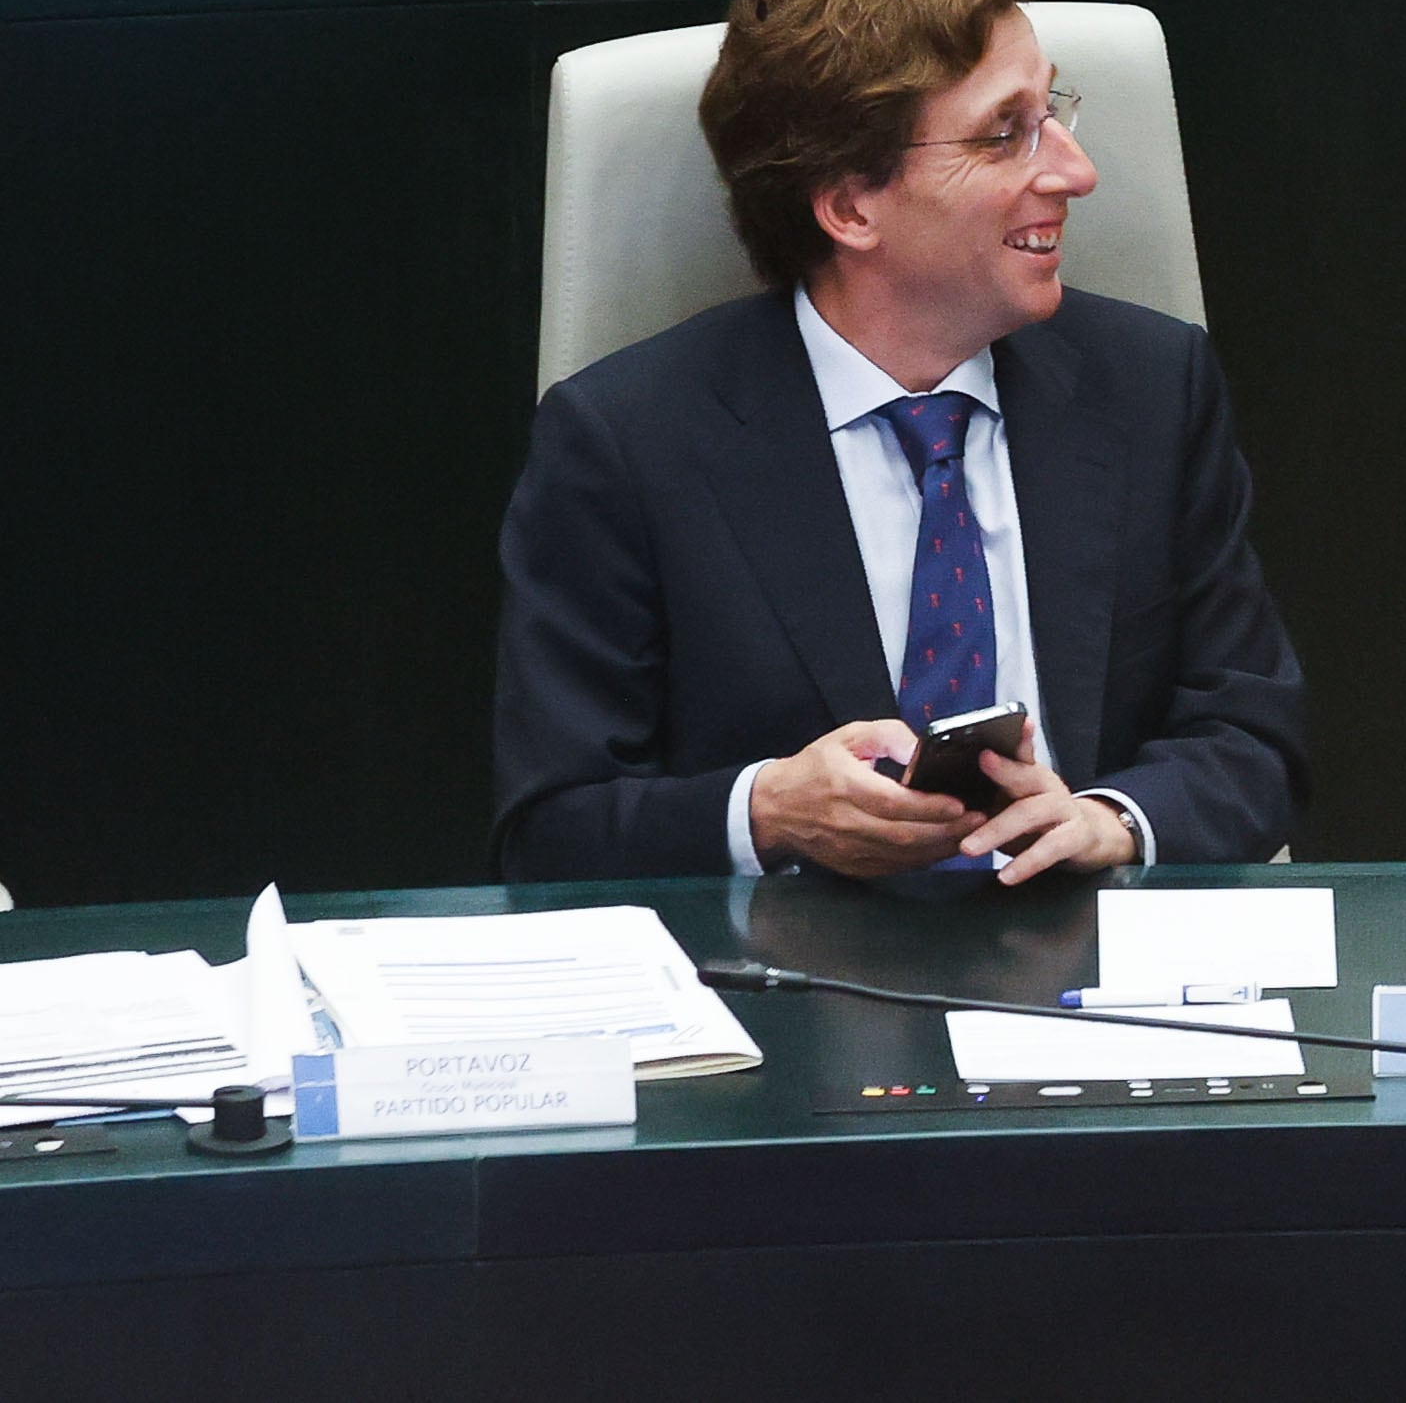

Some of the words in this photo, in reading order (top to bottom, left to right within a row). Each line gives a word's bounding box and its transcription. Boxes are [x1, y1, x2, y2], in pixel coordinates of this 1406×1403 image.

[405, 1052, 532, 1077] PORTAVOZ
[372, 1096, 466, 1118] PARTIDO
[473, 1091, 569, 1112] POPULAR
